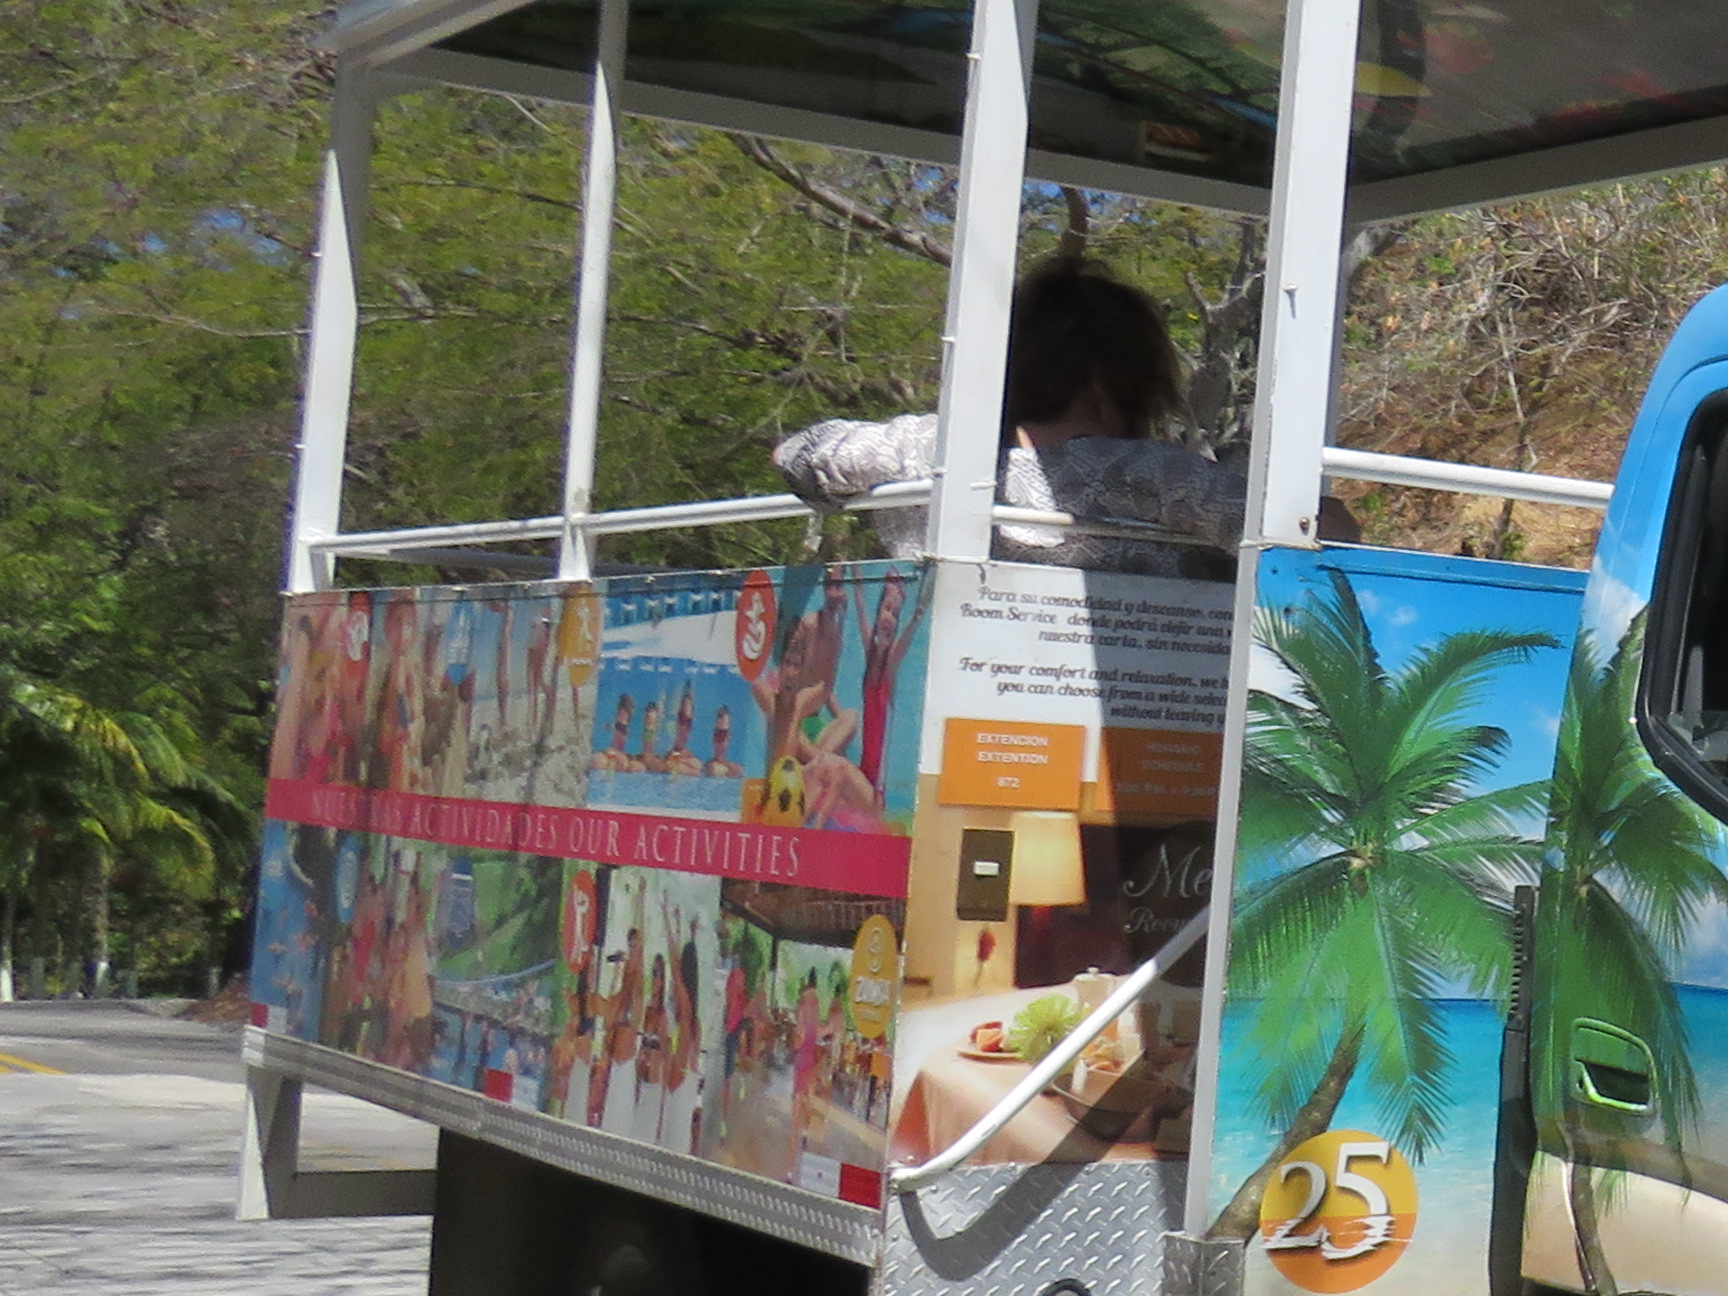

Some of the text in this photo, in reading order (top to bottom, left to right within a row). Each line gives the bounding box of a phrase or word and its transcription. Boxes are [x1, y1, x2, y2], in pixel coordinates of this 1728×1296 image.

[979, 585, 1017, 603] Para
[960, 603, 1005, 620] Room
[1007, 606, 1058, 625] Service
[1038, 630, 1094, 645] nuestra
[1171, 641, 1230, 655] necesida
[960, 656, 988, 672] For
[990, 662, 1026, 677] your
[1029, 663, 1087, 682] comfort
[1089, 668, 1118, 682] and
[997, 681, 1025, 696] you
[1027, 684, 1055, 695] can
[1058, 683, 1107, 698] choose
[569, 815, 620, 857] OUR
[633, 829, 803, 879] ACTIVITIES
[1260, 1140, 1398, 1261] 25
